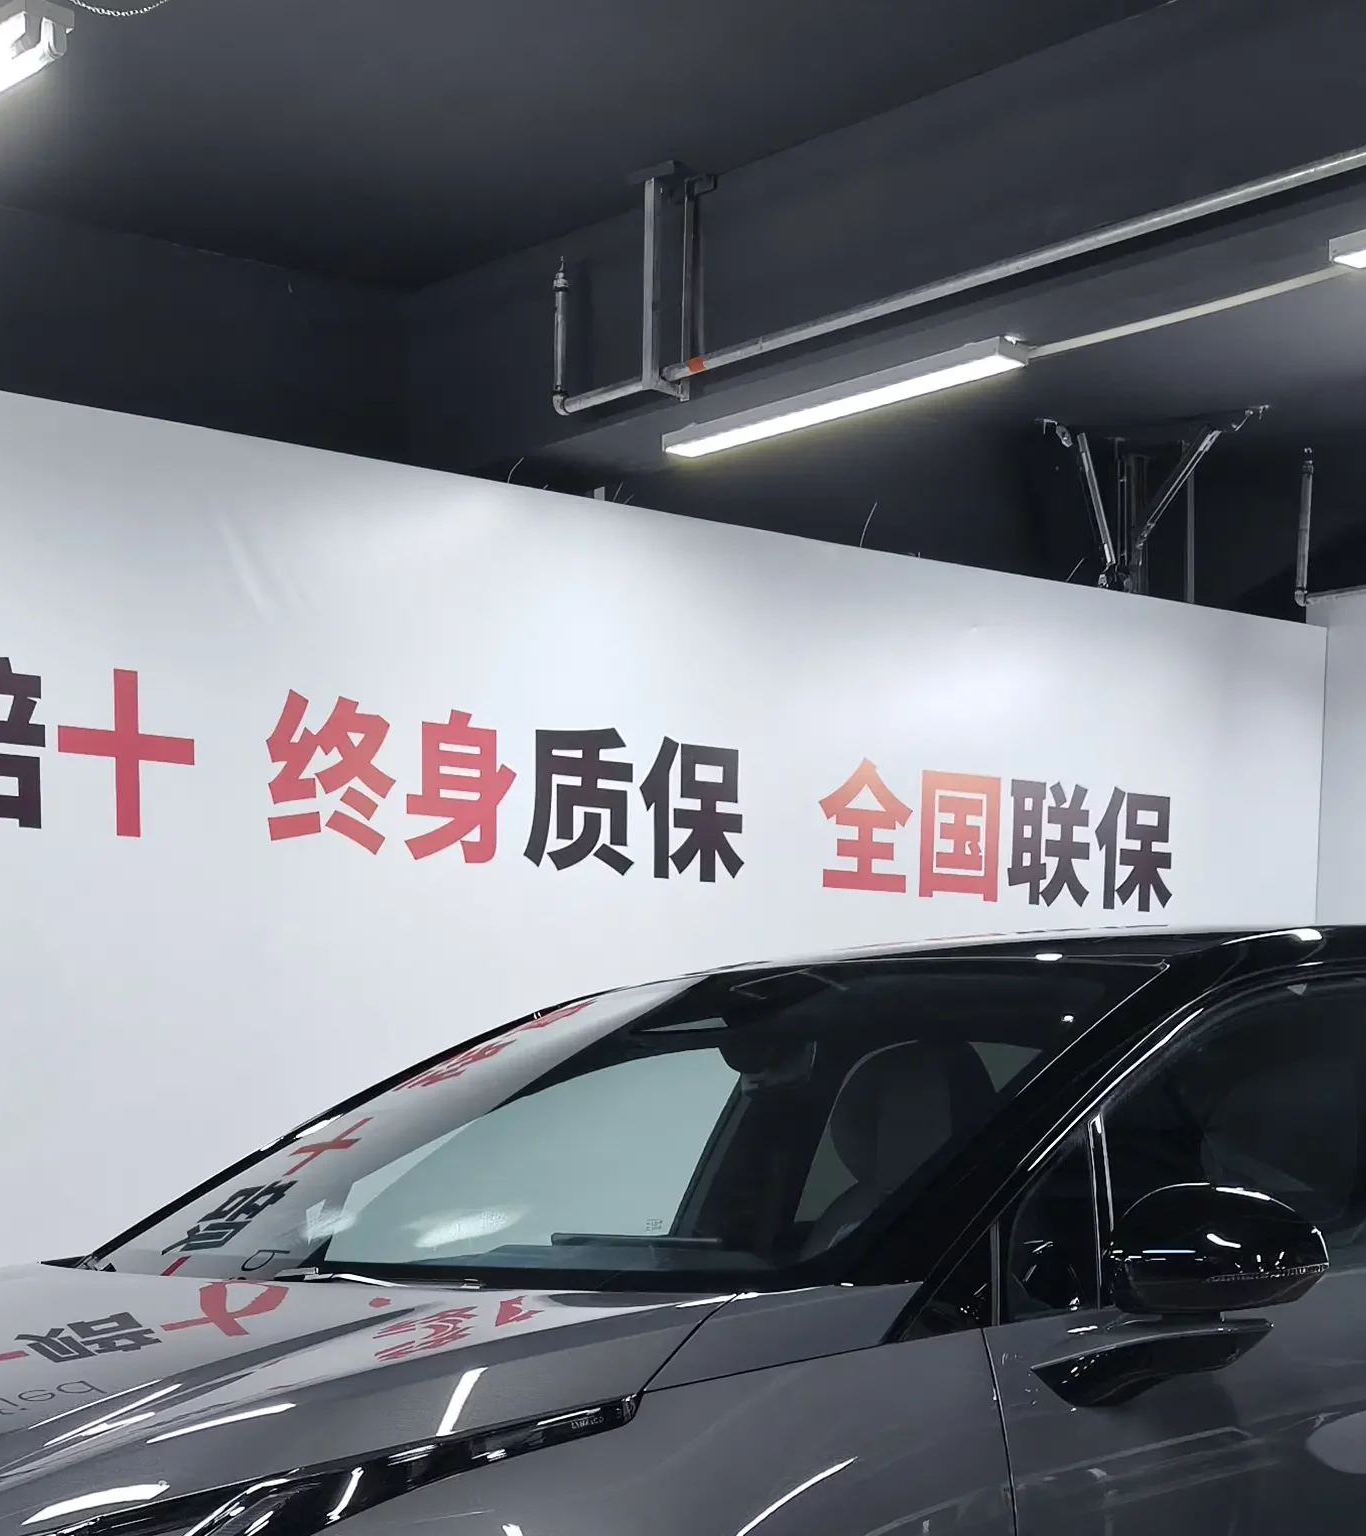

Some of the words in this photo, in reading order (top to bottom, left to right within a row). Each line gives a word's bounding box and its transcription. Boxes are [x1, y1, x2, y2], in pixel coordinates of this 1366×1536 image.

[265, 688, 745, 884] 终身质保
[818, 757, 1173, 911] 全国联保
